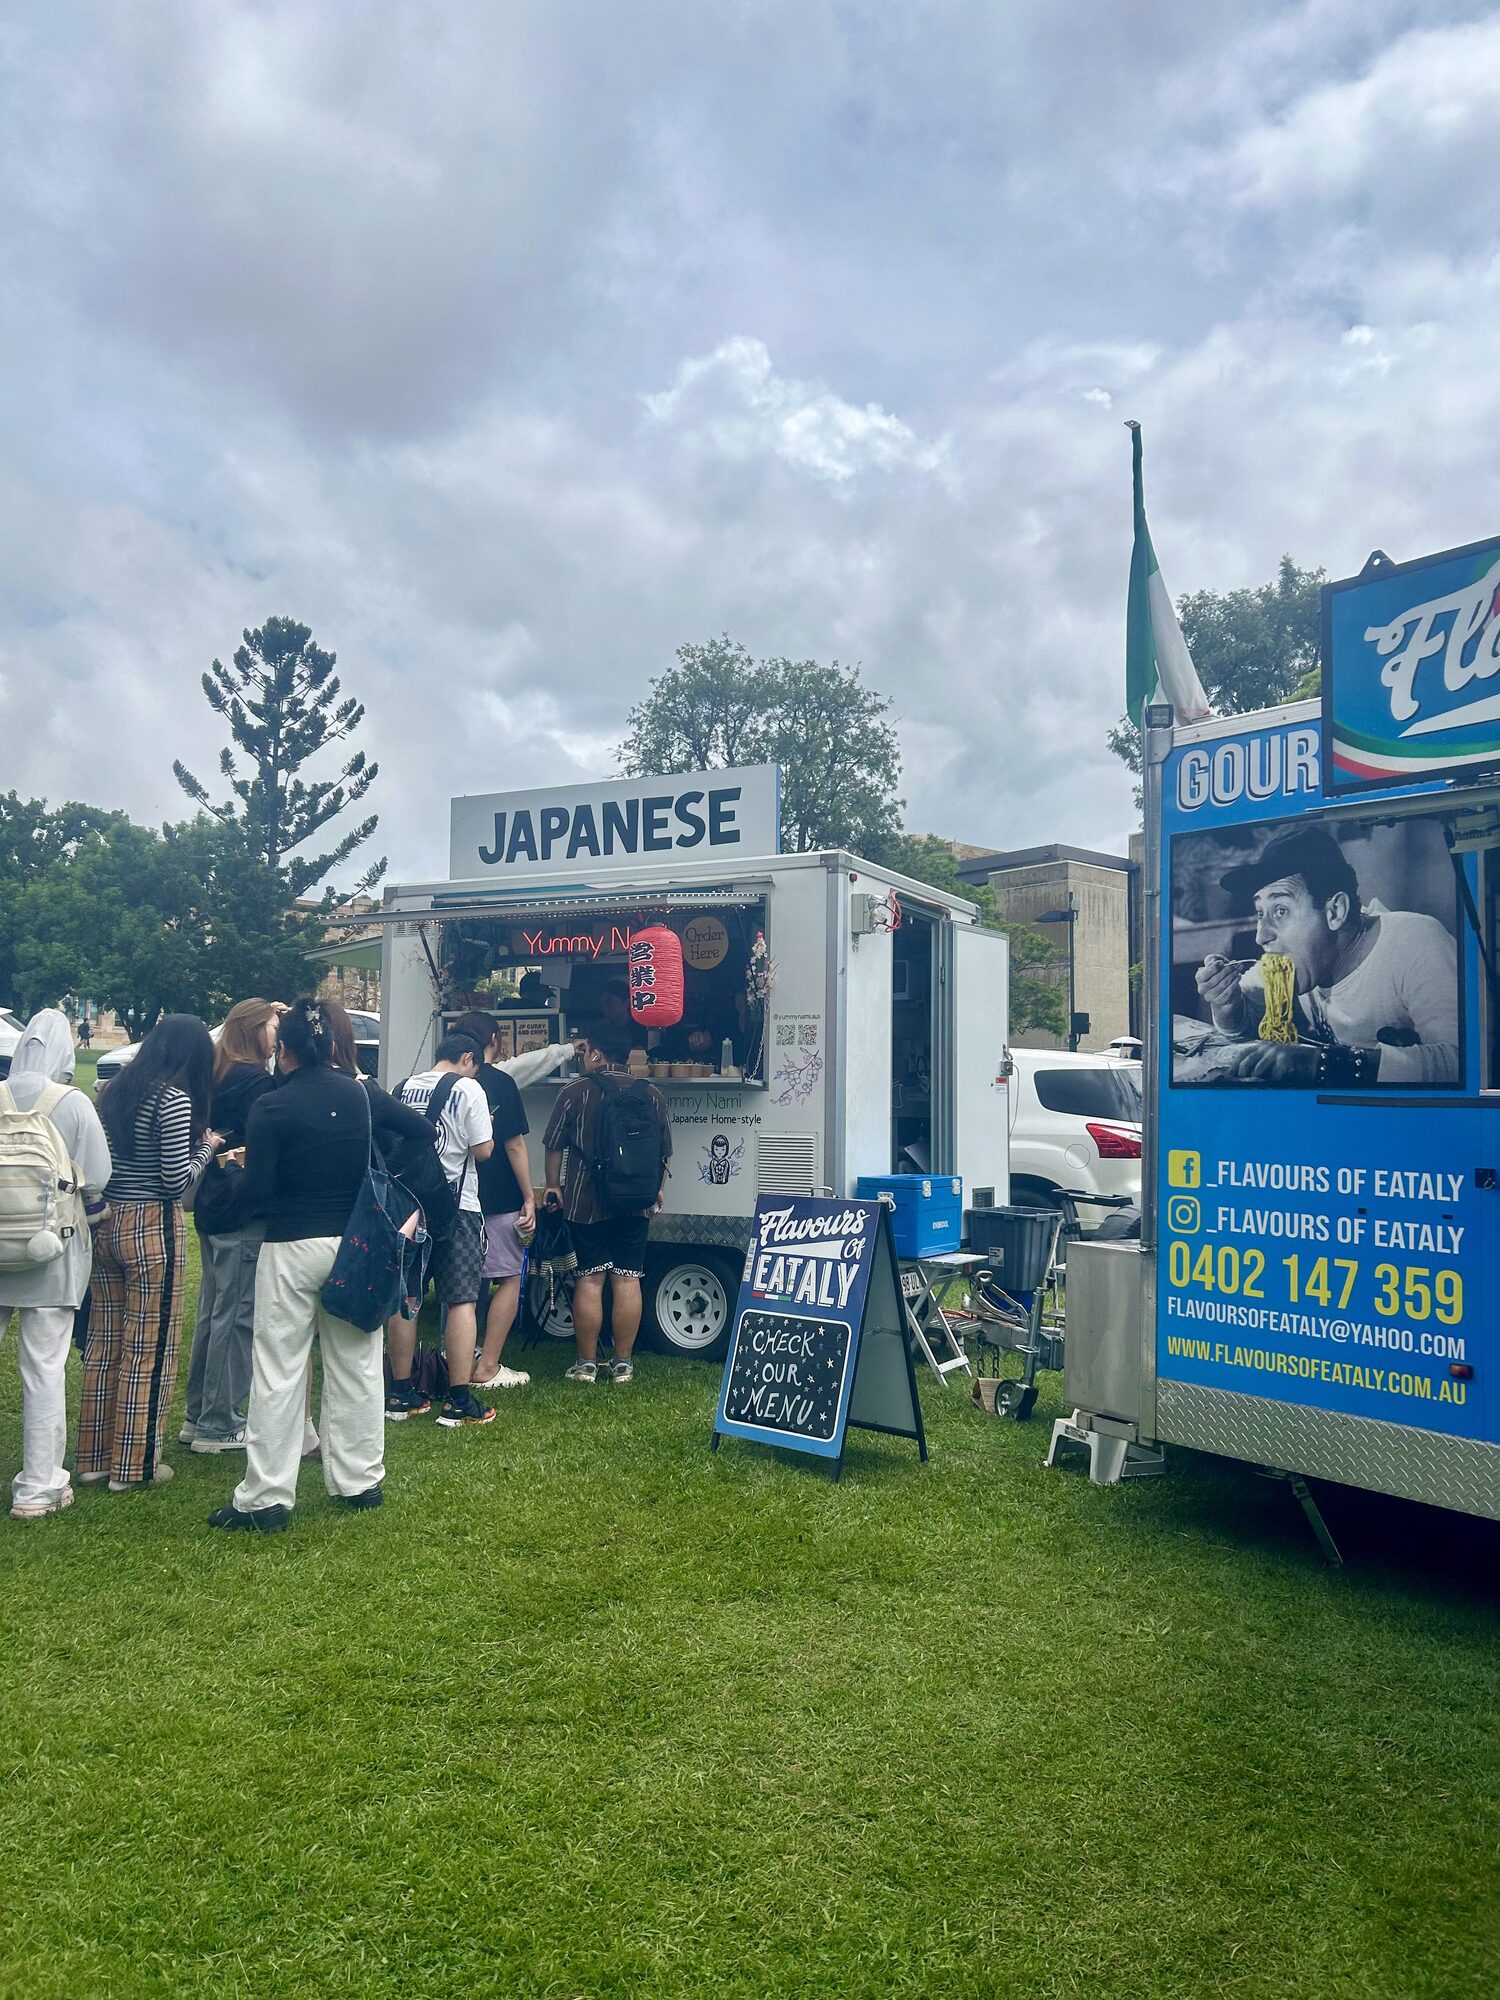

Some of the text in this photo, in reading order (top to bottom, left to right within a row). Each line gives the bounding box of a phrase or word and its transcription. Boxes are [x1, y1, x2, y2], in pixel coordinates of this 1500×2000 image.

[478, 787, 742, 865] JAPANESE
[522, 930, 604, 959] Yummy
[685, 926, 725, 943] Order
[689, 944, 721, 961] Here
[706, 1092, 742, 1110] Nami
[671, 1113, 762, 1126] Japanese Home-style
[1337, 1168, 1366, 1195] OF
[1374, 1170, 1465, 1202] EATALY
[758, 1204, 871, 1247] Flavours
[1337, 1216, 1366, 1245] OF
[1374, 1219, 1465, 1255] EATALY
[843, 1237, 866, 1260] Of
[752, 1253, 860, 1309] EATALY
[1169, 1240, 1464, 1325] 0402 147 359
[752, 1328, 816, 1357] CHECK
[1167, 1296, 1466, 1360] FLAVOURSOFEATALY@YAHOO.COM
[762, 1362, 802, 1387] OUR
[1167, 1336, 1466, 1405] WWW.FLAVOURSOFEATALY.COM.AU
[740, 1384, 815, 1425] MENU
